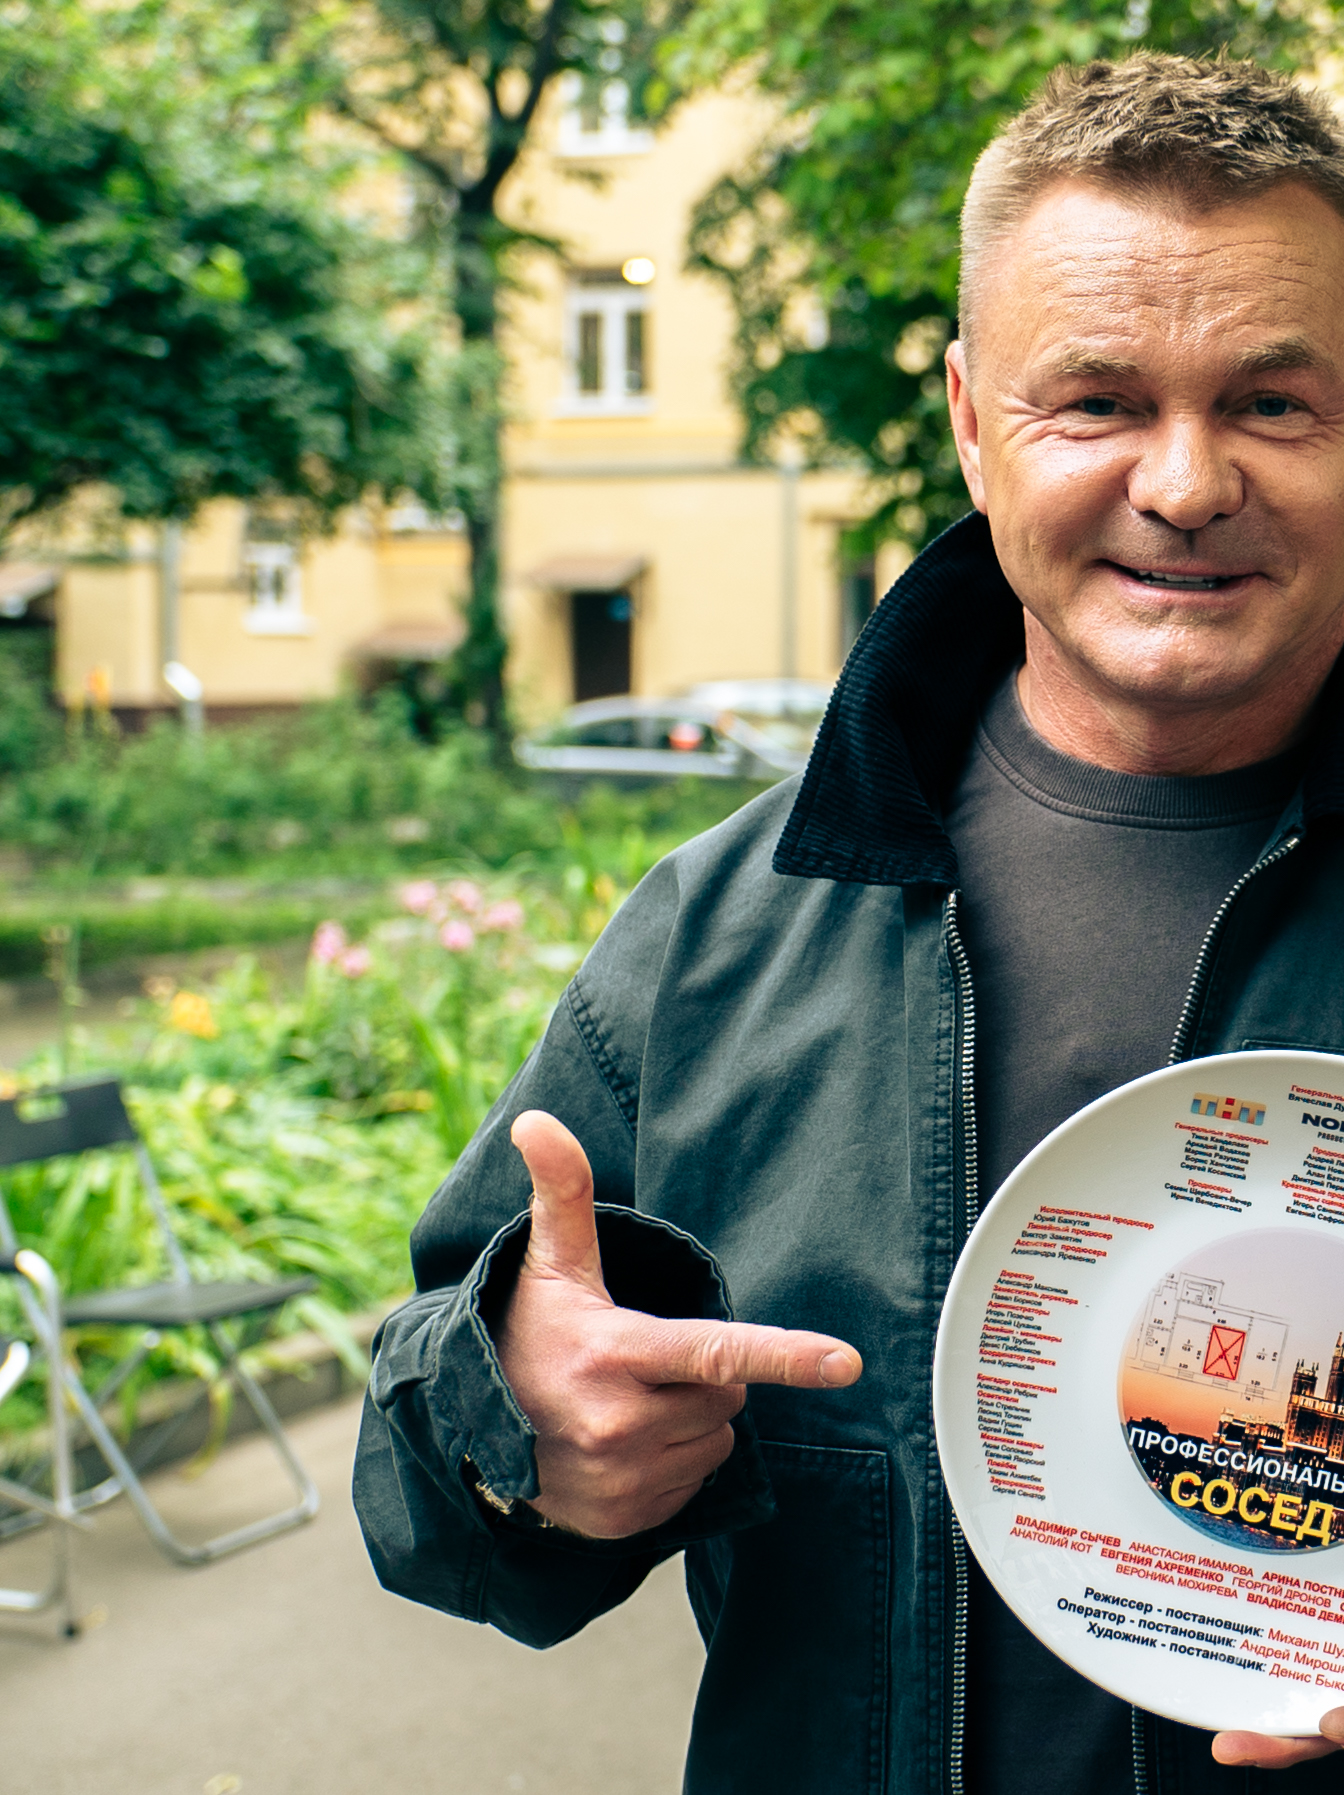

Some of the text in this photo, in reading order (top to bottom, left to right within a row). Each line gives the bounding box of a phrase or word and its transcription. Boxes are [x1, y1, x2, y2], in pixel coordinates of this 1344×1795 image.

[1288, 1093, 1333, 1107] Вячеслав
[1171, 1472, 1333, 1545] СОСЕД
[1010, 1526, 1093, 1553] АНАТОЛИЙ КОТ
[1015, 1514, 1121, 1547] ВЛАДИМИР СЫЧЕВ
[1100, 1547, 1224, 1582] ЕВГЕНИЯ АХРЕМЕНКО
[1128, 1541, 1254, 1576] АНАСТАСИЯ ИМАМОВА
[1115, 1563, 1238, 1598] ВЕРОНИКА МОХИРЕВА
[1232, 1576, 1332, 1607] ГЕОРГИЙ ДРОНОВ
[1261, 1571, 1301, 1588] АРИНА
[1084, 1587, 1153, 1614] Режиссер
[1165, 1607, 1264, 1637] постановщик:
[1267, 1627, 1320, 1650] Михаил
[1246, 1592, 1317, 1616] ВЛАДИСЛАВ
[1057, 1597, 1126, 1625] Оператор
[1138, 1619, 1236, 1647] постановщик:
[1239, 1639, 1291, 1660] Андрей
[1086, 1621, 1157, 1647] Художник
[1169, 1642, 1266, 1671] постановщик:
[1268, 1662, 1312, 1682] Денис
